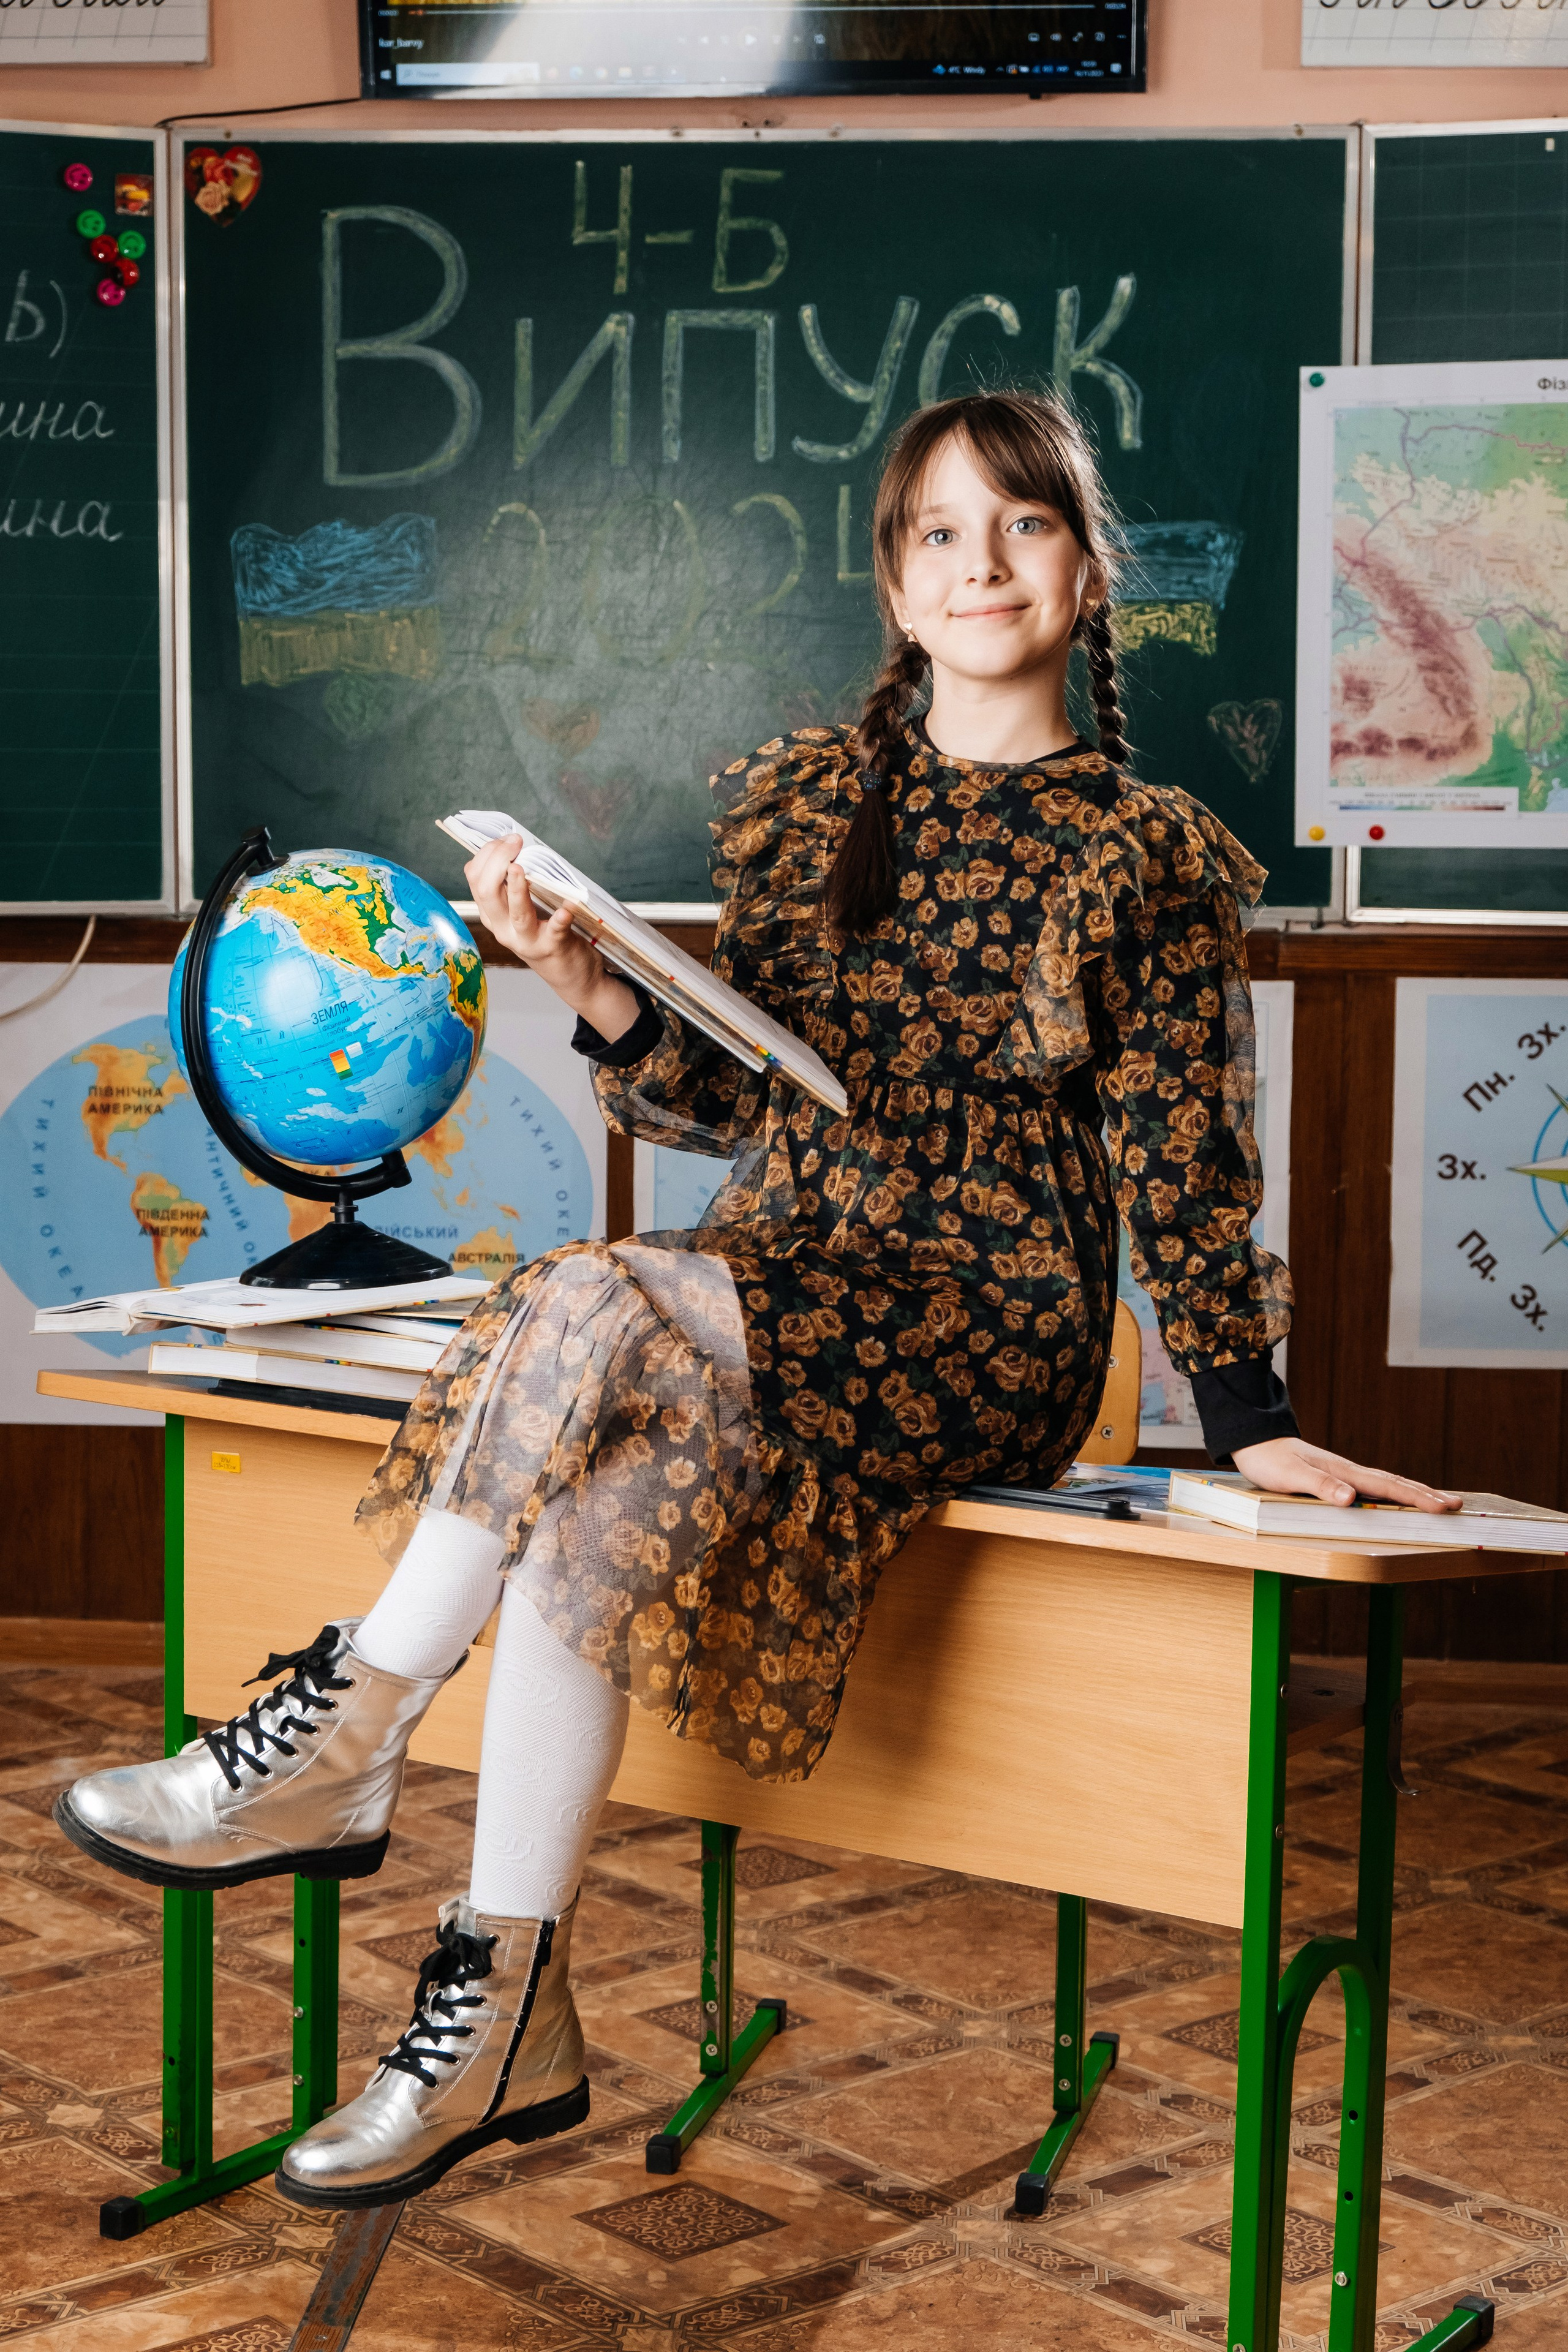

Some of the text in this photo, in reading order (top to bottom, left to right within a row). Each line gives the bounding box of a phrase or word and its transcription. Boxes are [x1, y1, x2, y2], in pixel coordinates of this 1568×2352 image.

[1537, 377, 1568, 390] Фіз
[311, 1000, 349, 1025] ЗЕМЛЯ
[1462, 1022, 1566, 1112] Пн. Зх.
[88, 1085, 163, 1097] ПІВНІЧНА
[88, 1102, 164, 1114] АМЕРИКА
[1437, 1154, 1487, 1180] Зх.
[136, 1207, 210, 1221] ПІВДЕННА
[556, 1189, 570, 1246] ОКЕ
[138, 1226, 208, 1237] АМЕРИКА
[448, 1252, 526, 1264] АВСТРАЛІЯ
[1457, 1229, 1548, 1332] Пд. Зх.
